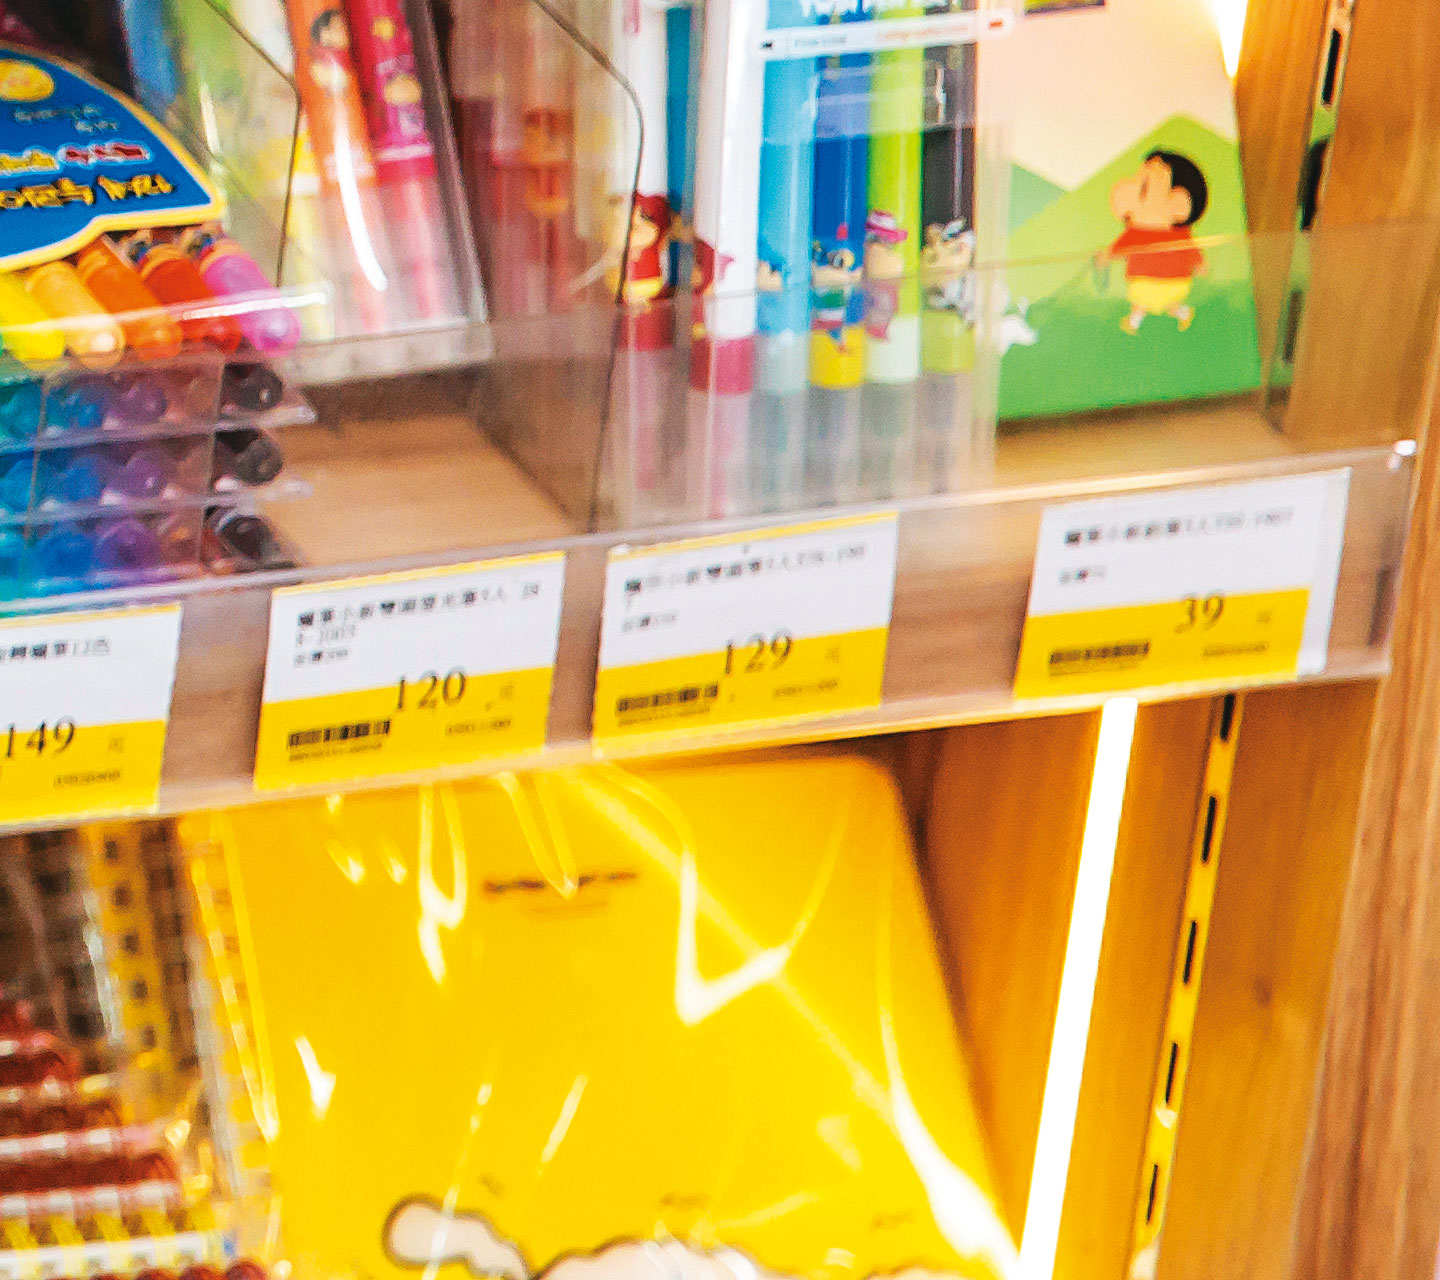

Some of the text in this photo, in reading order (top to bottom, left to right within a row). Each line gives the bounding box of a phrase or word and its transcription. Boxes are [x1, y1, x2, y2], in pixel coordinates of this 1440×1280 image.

[721, 630, 794, 676] 129
[393, 667, 467, 713] 120
[2, 716, 77, 761] 149
